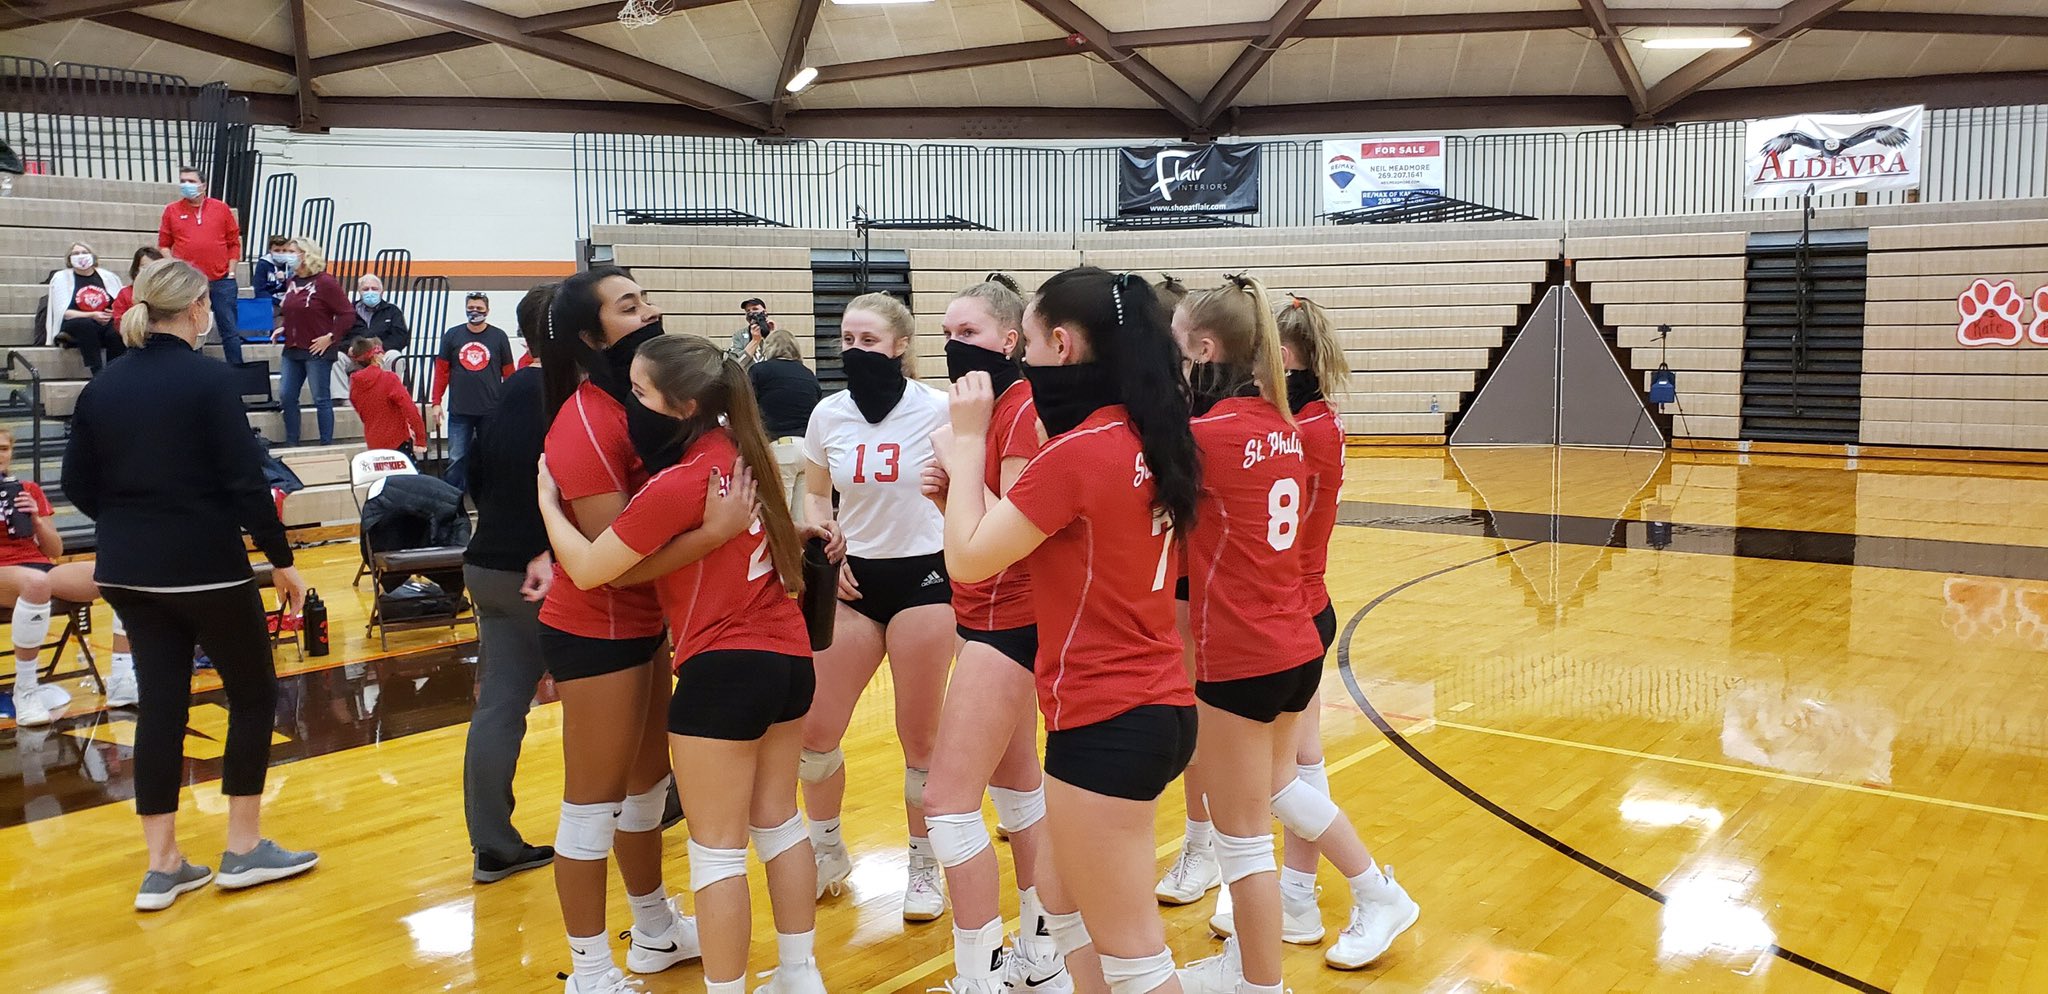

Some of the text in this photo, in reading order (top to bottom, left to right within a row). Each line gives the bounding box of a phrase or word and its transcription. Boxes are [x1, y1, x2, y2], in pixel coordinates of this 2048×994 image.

[1375, 145, 1426, 155] FOR SALE
[1370, 165, 1387, 173] NEIL
[1754, 149, 1910, 182] ALDEVRA
[1149, 150, 1206, 201] Flair
[1378, 171, 1423, 180] 269.207.1641
[1177, 183, 1228, 191] INTERIORS
[1362, 191, 1387, 199] RE/MAX
[1149, 203, 1227, 212] www.shopatflair.com
[372, 460, 408, 472] HUSKIES
[852, 442, 901, 484] 13
[1267, 477, 1300, 552] 8
